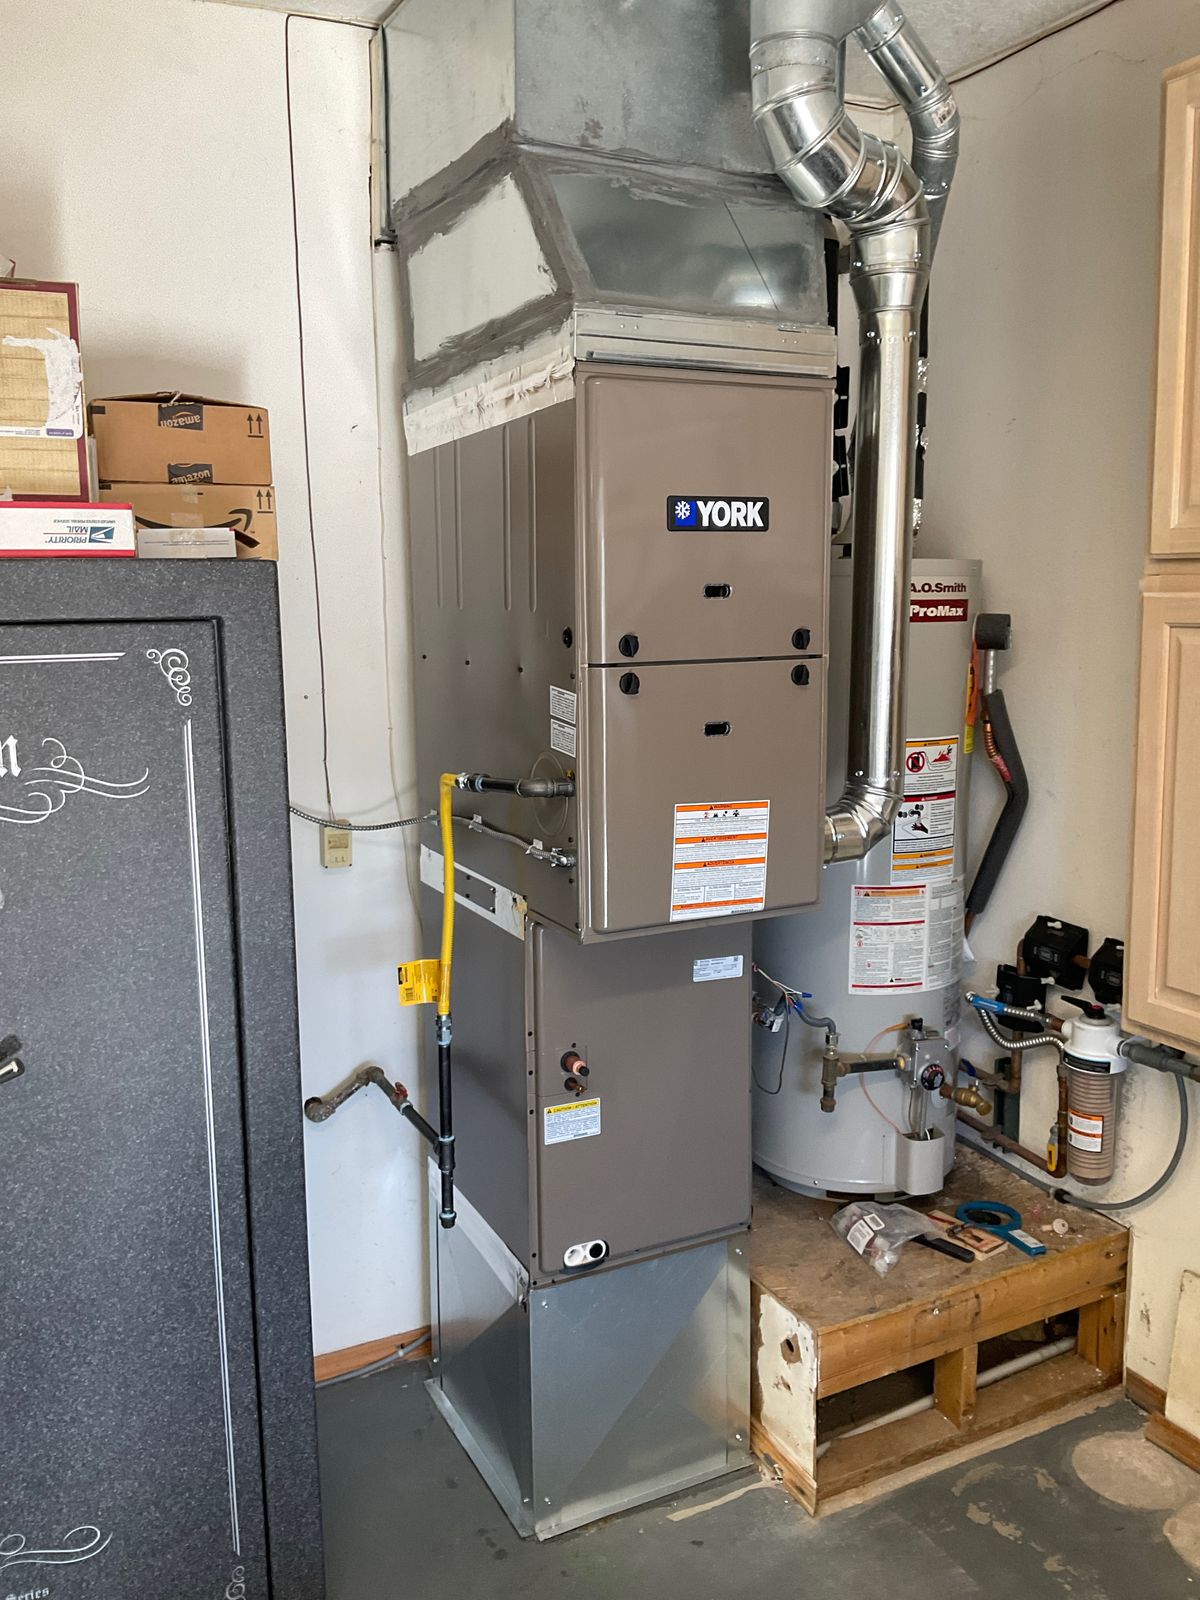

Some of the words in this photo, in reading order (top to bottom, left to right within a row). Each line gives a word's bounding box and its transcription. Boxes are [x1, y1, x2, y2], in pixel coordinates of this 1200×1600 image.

[160, 414, 201, 428] amazon
[696, 500, 764, 527] YORK
[66, 525, 89, 533] MAIL
[910, 605, 964, 617] ProMax
